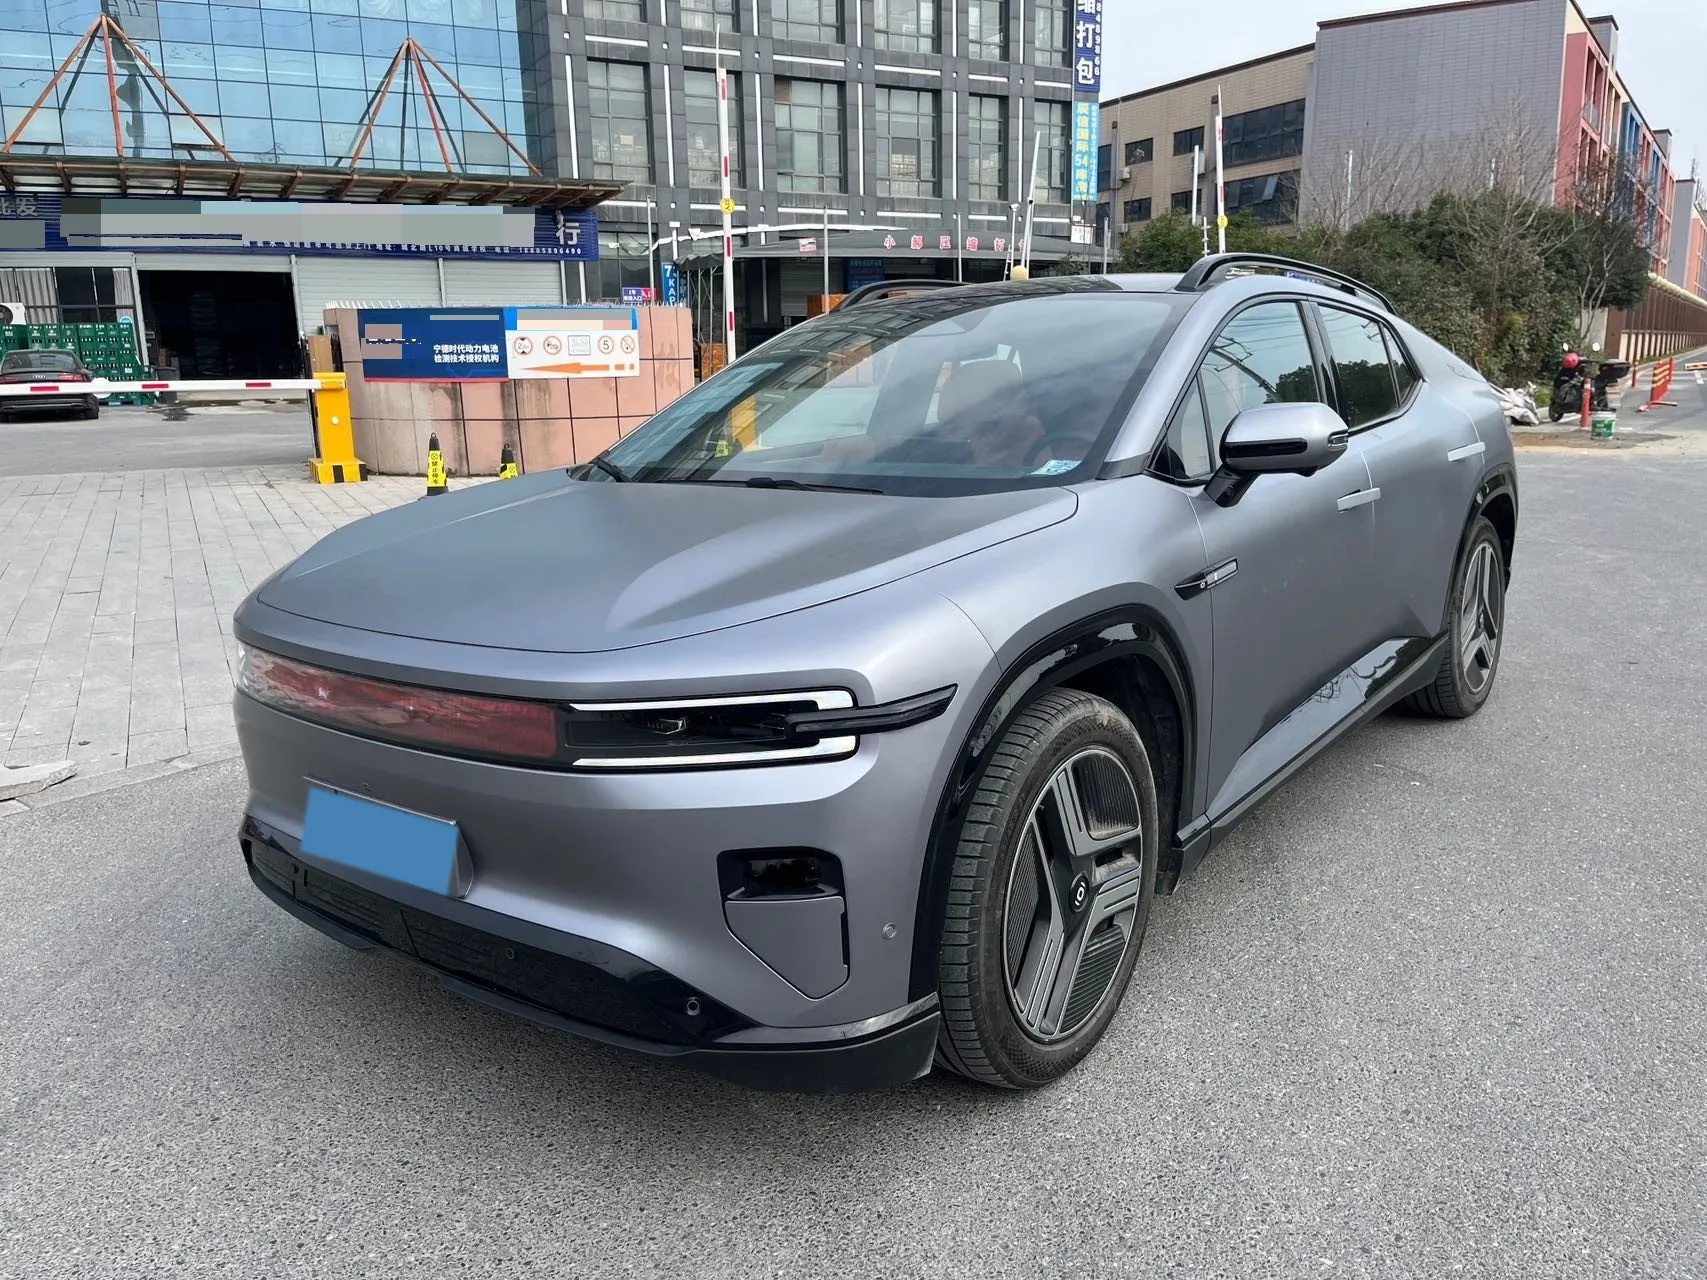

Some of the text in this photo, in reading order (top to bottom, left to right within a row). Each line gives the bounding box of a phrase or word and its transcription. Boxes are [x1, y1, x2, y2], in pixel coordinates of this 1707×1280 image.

[433, 344, 499, 354] 宁德时代动力电池
[602, 341, 610, 351] 5
[434, 353, 499, 363] 检测技术授权机构
